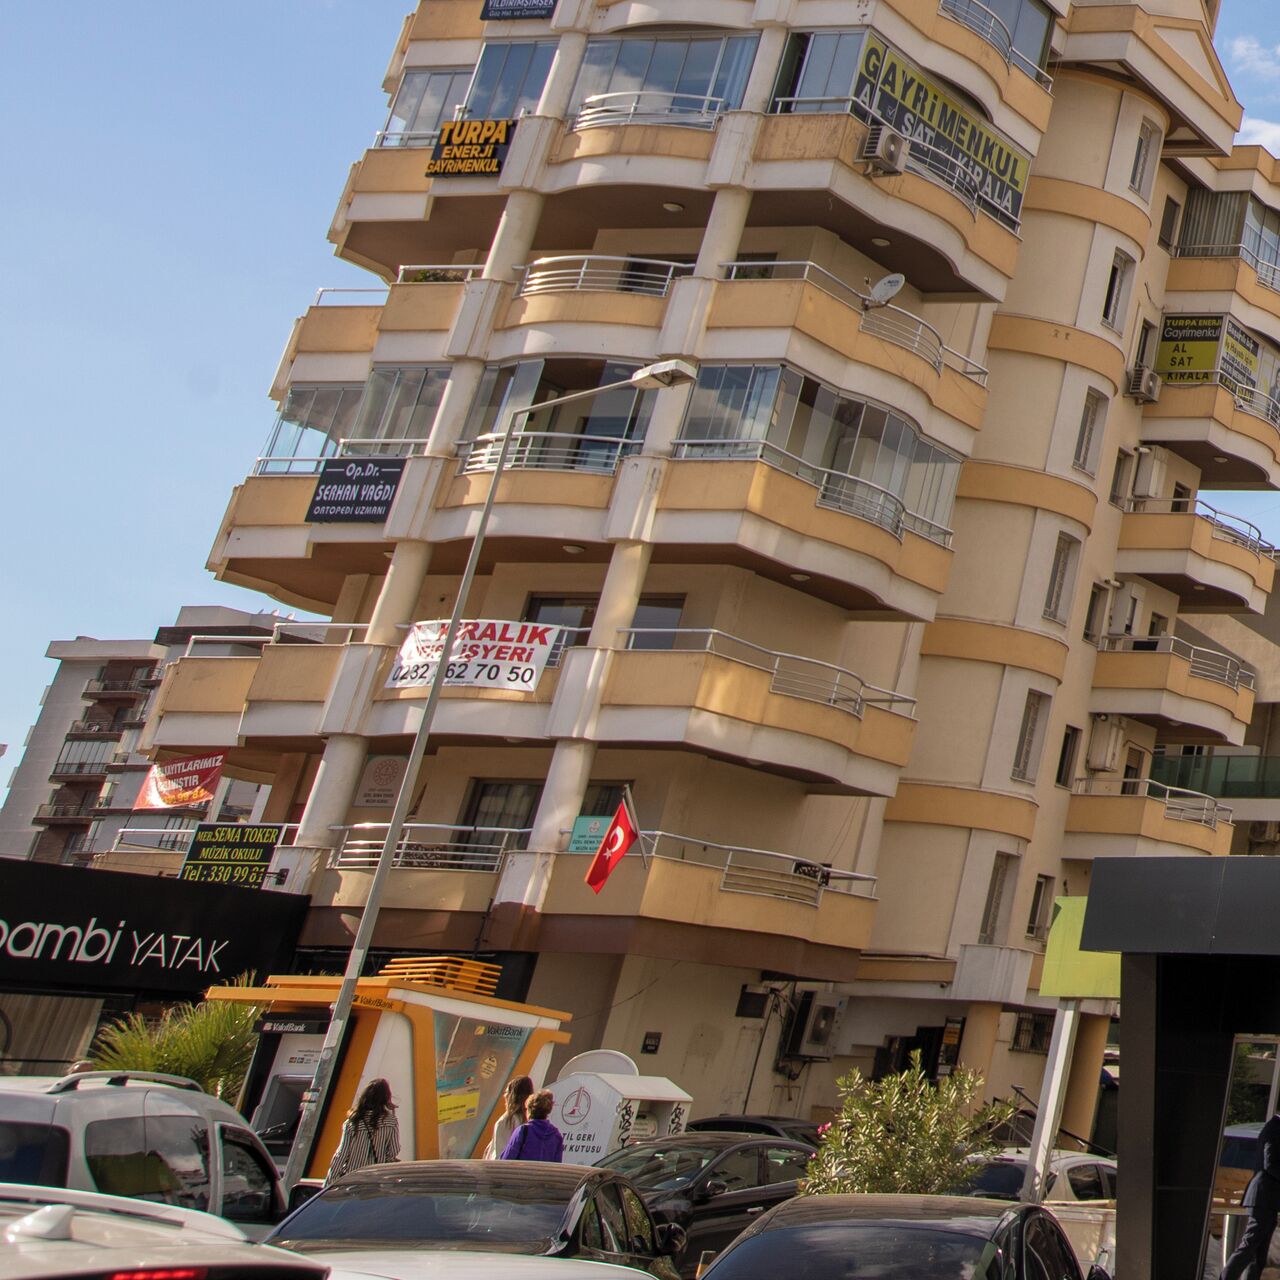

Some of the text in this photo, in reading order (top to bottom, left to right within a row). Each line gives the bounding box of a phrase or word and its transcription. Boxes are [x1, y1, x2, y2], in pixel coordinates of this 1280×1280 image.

[864, 46, 1020, 188] GAYRİMENKUL
[440, 120, 508, 144] TURPA
[901, 113, 935, 147] SAT
[441, 144, 494, 159] ENERJİ
[426, 158, 500, 173] GAYRİMENKUL
[1164, 327, 1221, 338] Gayrimenkul
[1172, 344, 1187, 353] AL
[1170, 356, 1194, 367] SAT
[316, 480, 396, 501] SERHAN YAĞDI
[392, 663, 534, 684] 0232 62 70 50
[243, 828, 279, 843] TOKER
[200, 846, 264, 861] MÜZİK OKULU
[208, 865, 233, 882] 330
[232, 865, 249, 882] 99
[130, 929, 230, 973] YATAK
[576, 1132, 596, 1142] GERİ
[568, 1144, 602, 1154] KUTUSU
